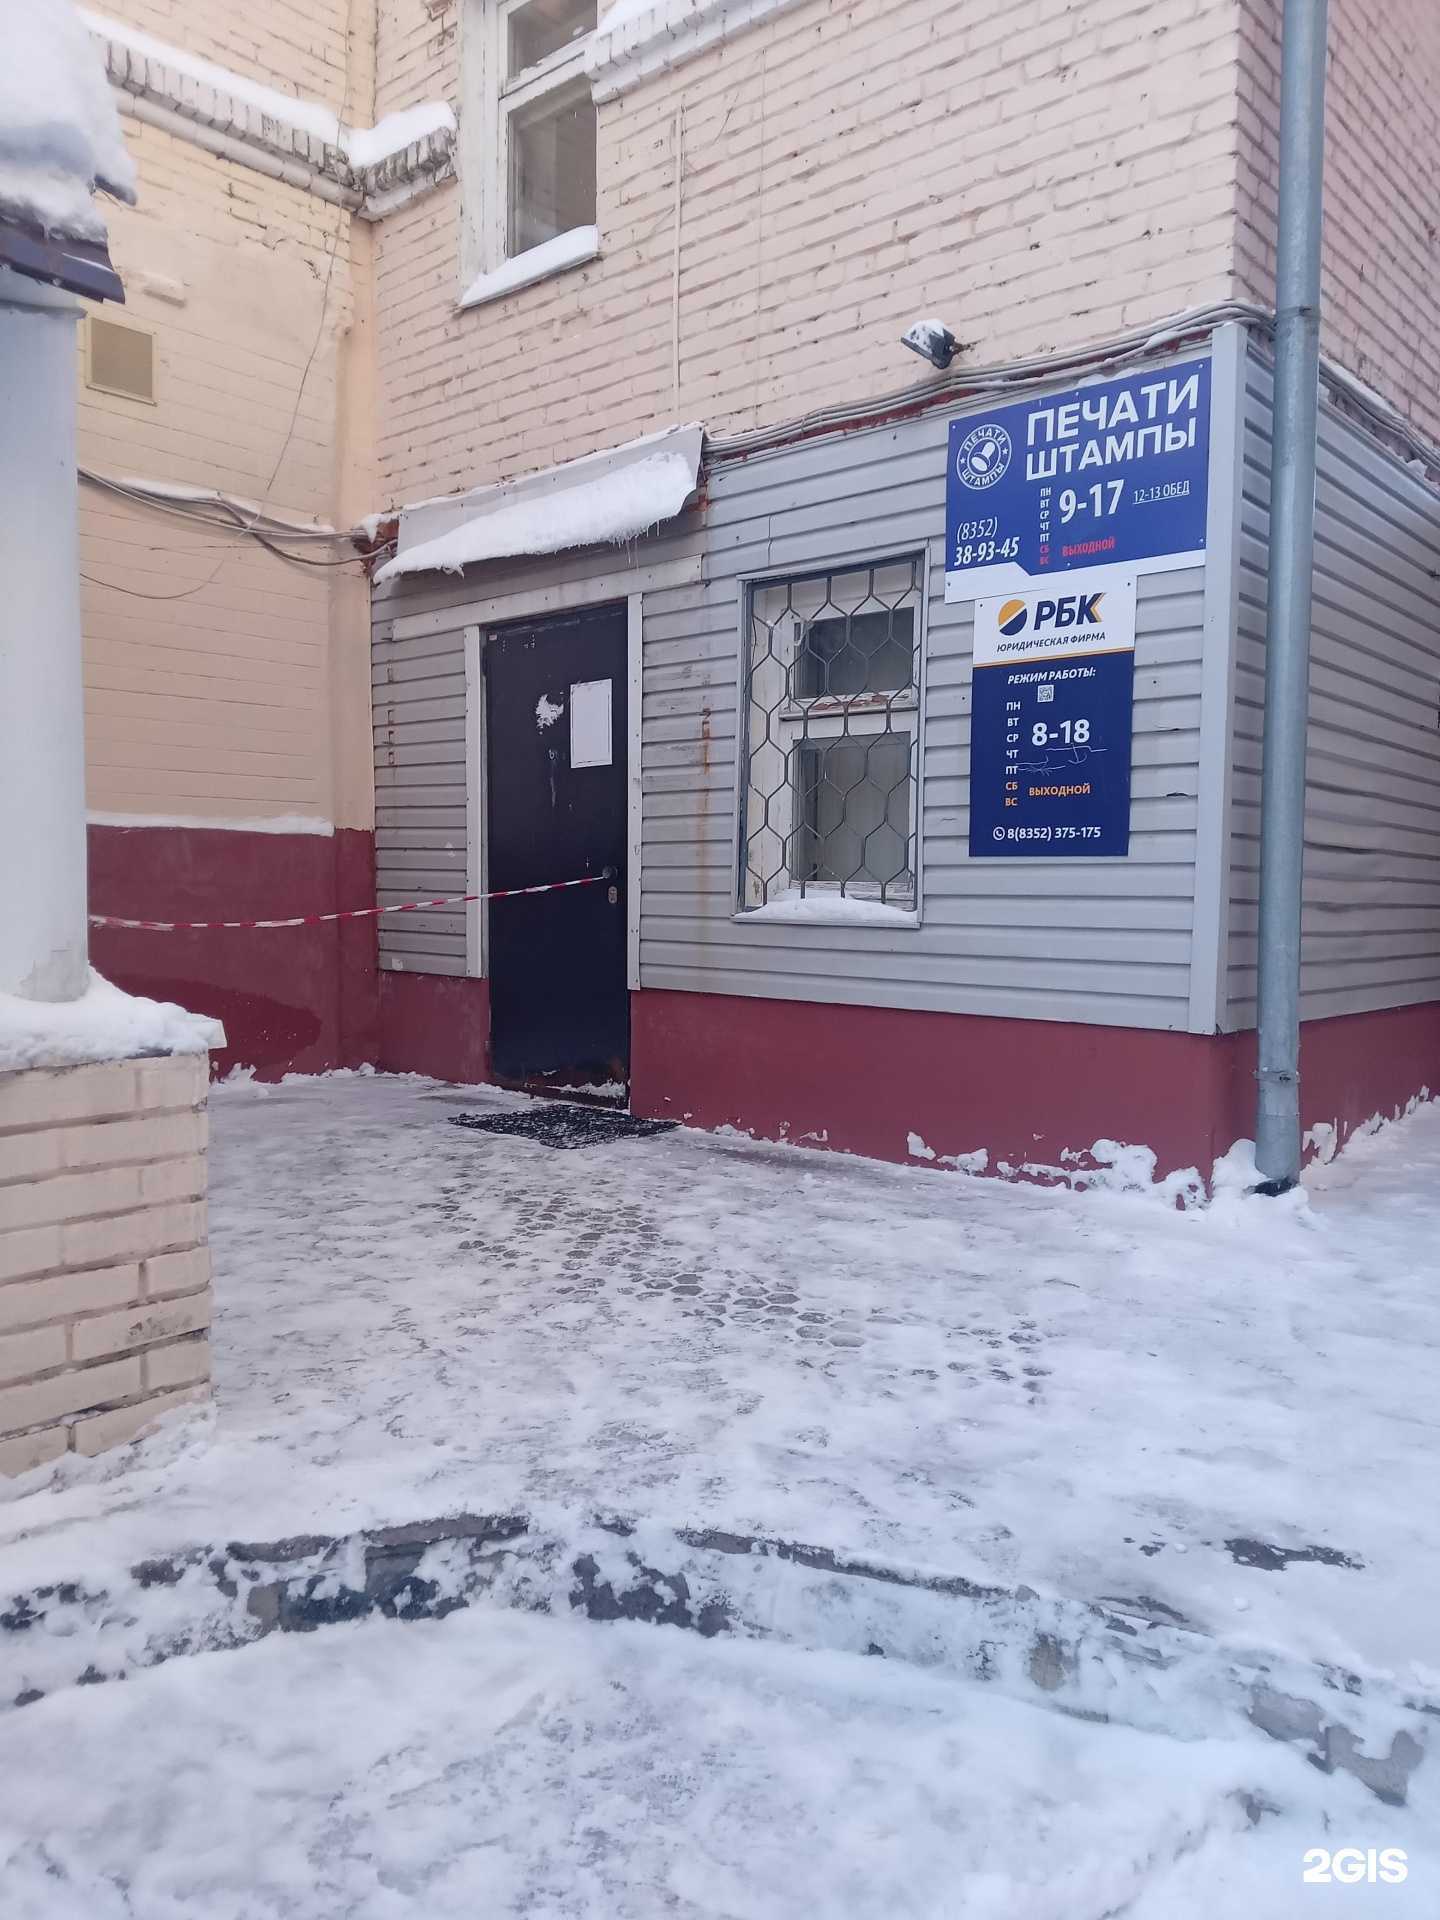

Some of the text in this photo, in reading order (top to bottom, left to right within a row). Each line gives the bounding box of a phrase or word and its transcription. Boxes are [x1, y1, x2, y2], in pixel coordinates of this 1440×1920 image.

[1027, 375, 1199, 446] ПЕЧАТИ
[964, 429, 1005, 452] ПЕЧАТИ
[1026, 417, 1196, 481] ШТАМПЫ
[962, 462, 1005, 486] ШТАМПЫ
[1040, 487, 1051, 497] ПН
[1133, 480, 1191, 503] 12-13 ОБЕД
[1040, 498, 1050, 508] ВТ
[1059, 479, 1125, 524] 9-17
[1040, 510, 1050, 520] СР
[956, 516, 998, 543] (8352)
[1040, 521, 1050, 532] ЧТ
[1040, 533, 1050, 543] ПТ
[954, 536, 1020, 567] 38-93-45
[1033, 592, 1106, 630] РБК
[997, 631, 1106, 652] ЮРИДИЧЕСКАЯ ФИРМА
[1008, 667, 1096, 685] РЕЖИМ РАБОТЫ:
[1006, 702, 1021, 711] ПН
[1007, 718, 1020, 727] ВТ
[1006, 734, 1019, 743] СР
[1031, 719, 1091, 746] 8-18
[1006, 750, 1019, 759] ЧТ
[1005, 766, 1018, 775] ПТ
[1005, 782, 1018, 791] СБ
[1029, 783, 1091, 797] ВЫХОДНОЙ
[1005, 798, 1018, 806] ВС
[1007, 827, 1101, 841] 8(8352) 375-175
